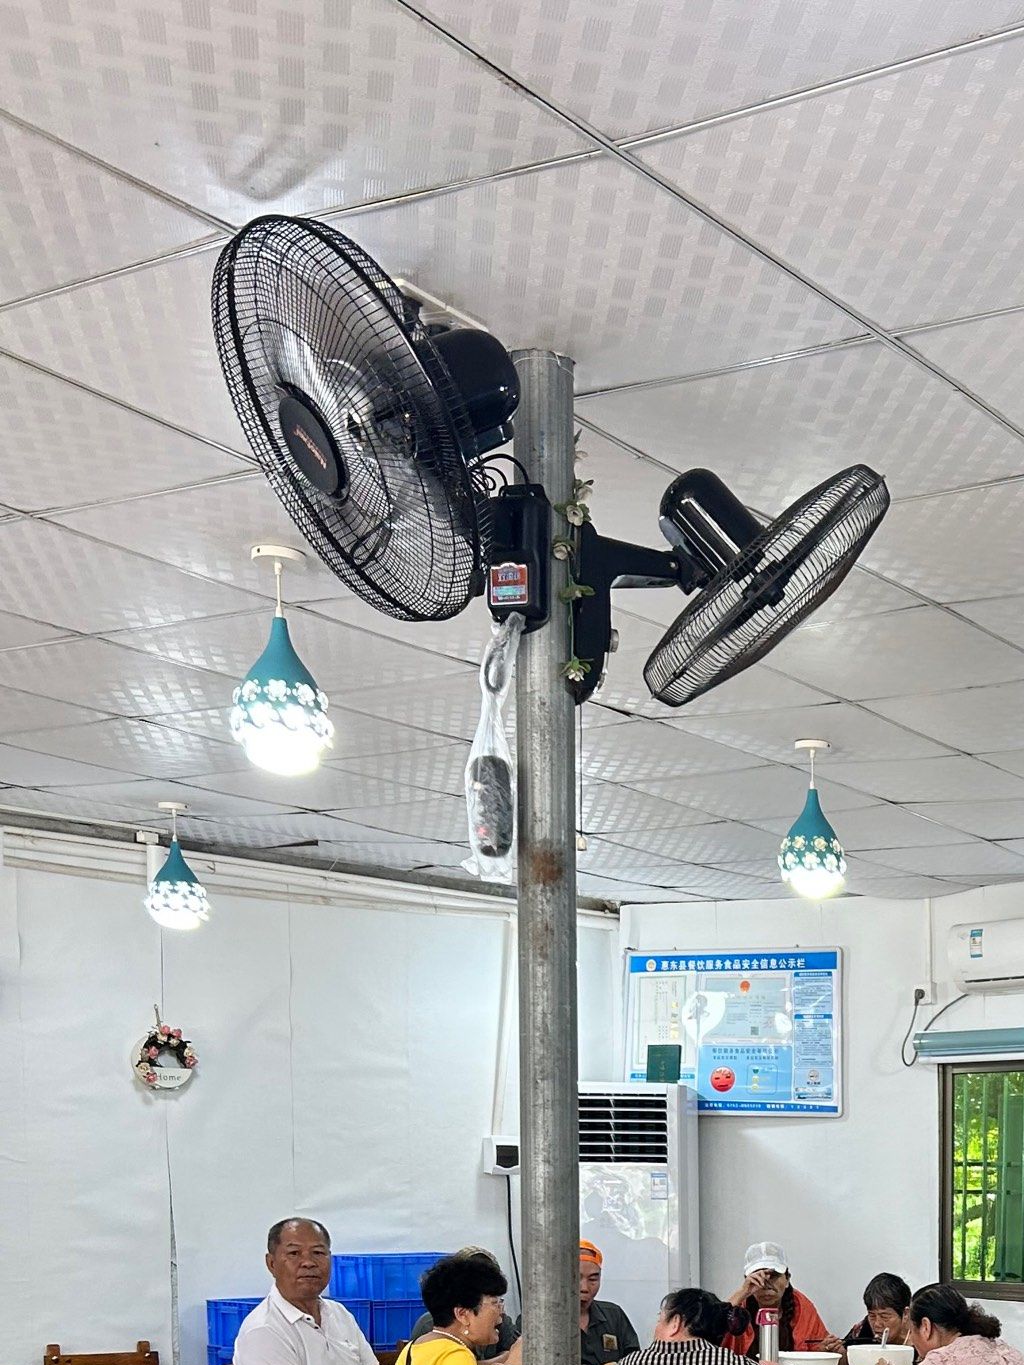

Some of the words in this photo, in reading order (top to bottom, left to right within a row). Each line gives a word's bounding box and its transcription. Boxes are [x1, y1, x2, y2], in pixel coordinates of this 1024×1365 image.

[660, 958, 806, 970] 惠东县餐饮服务食品安全信息公示栏
